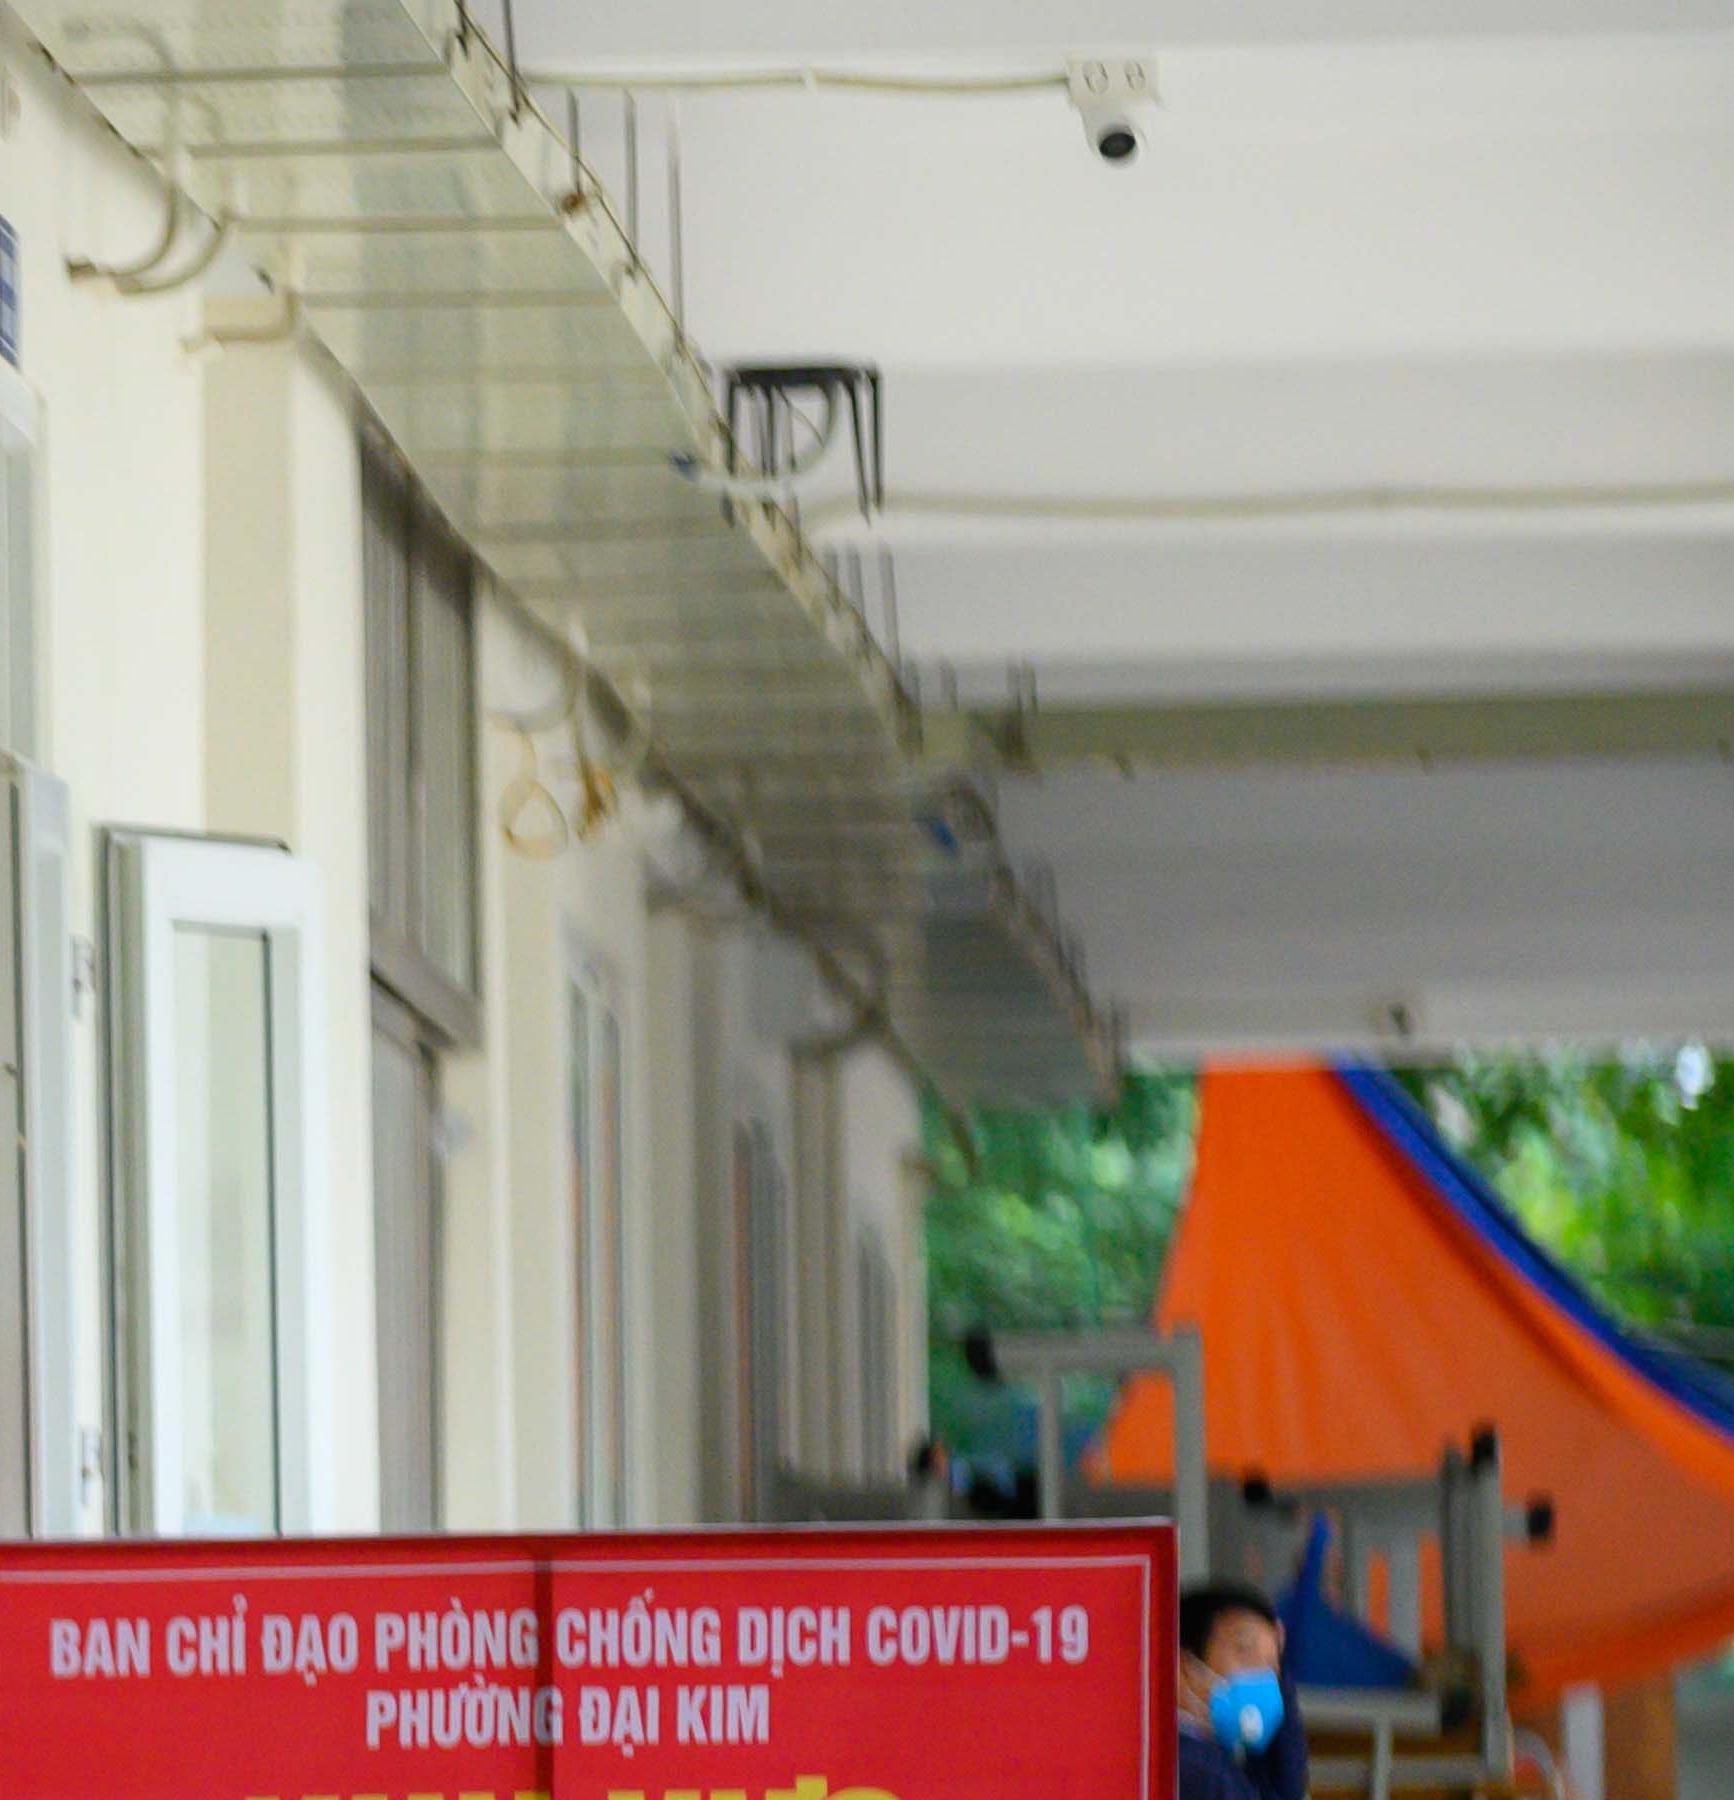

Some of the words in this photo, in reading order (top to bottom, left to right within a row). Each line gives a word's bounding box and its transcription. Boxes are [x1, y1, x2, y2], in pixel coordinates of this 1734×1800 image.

[50, 1618, 151, 1679] BAN
[165, 1594, 248, 1677] CHỈ
[261, 1612, 359, 1686] ĐẠO
[374, 1597, 539, 1672] PHÒNG
[555, 1589, 722, 1668] CHỐNG
[737, 1606, 851, 1678] DỊCH
[866, 1604, 1089, 1666] COVID-19
[365, 1673, 564, 1750] PHƯỜNG
[578, 1685, 660, 1758] ĐẠI
[676, 1684, 770, 1745] KIM
